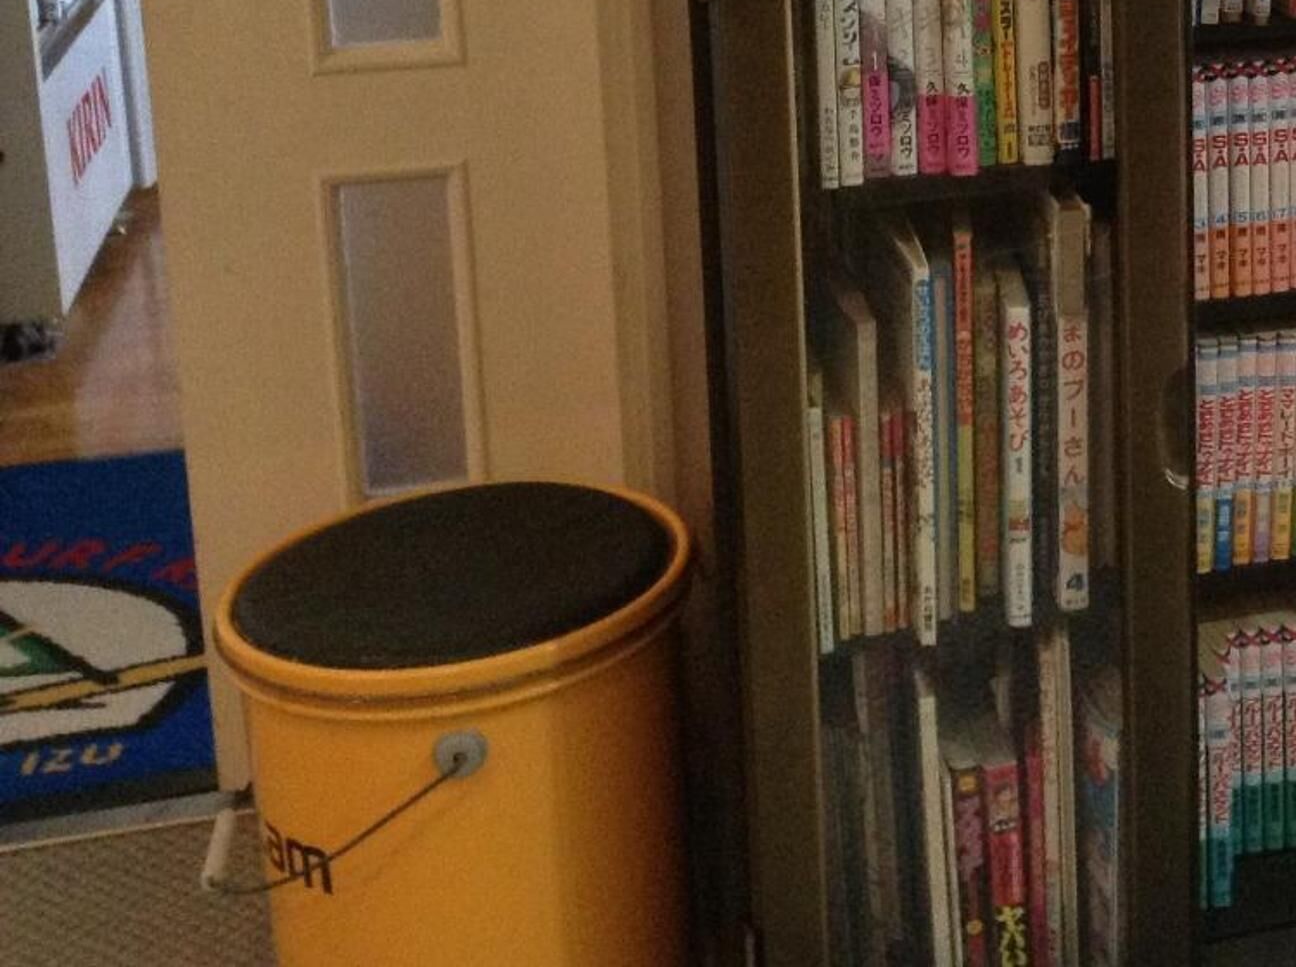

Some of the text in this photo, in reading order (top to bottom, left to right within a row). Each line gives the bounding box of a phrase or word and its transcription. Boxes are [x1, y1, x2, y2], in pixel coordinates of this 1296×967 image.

[956, 81, 971, 160] 久保ミツロウ
[1008, 322, 1030, 453] めいろあそび
[1065, 572, 1084, 593] 4
[19, 741, 125, 777] IZU
